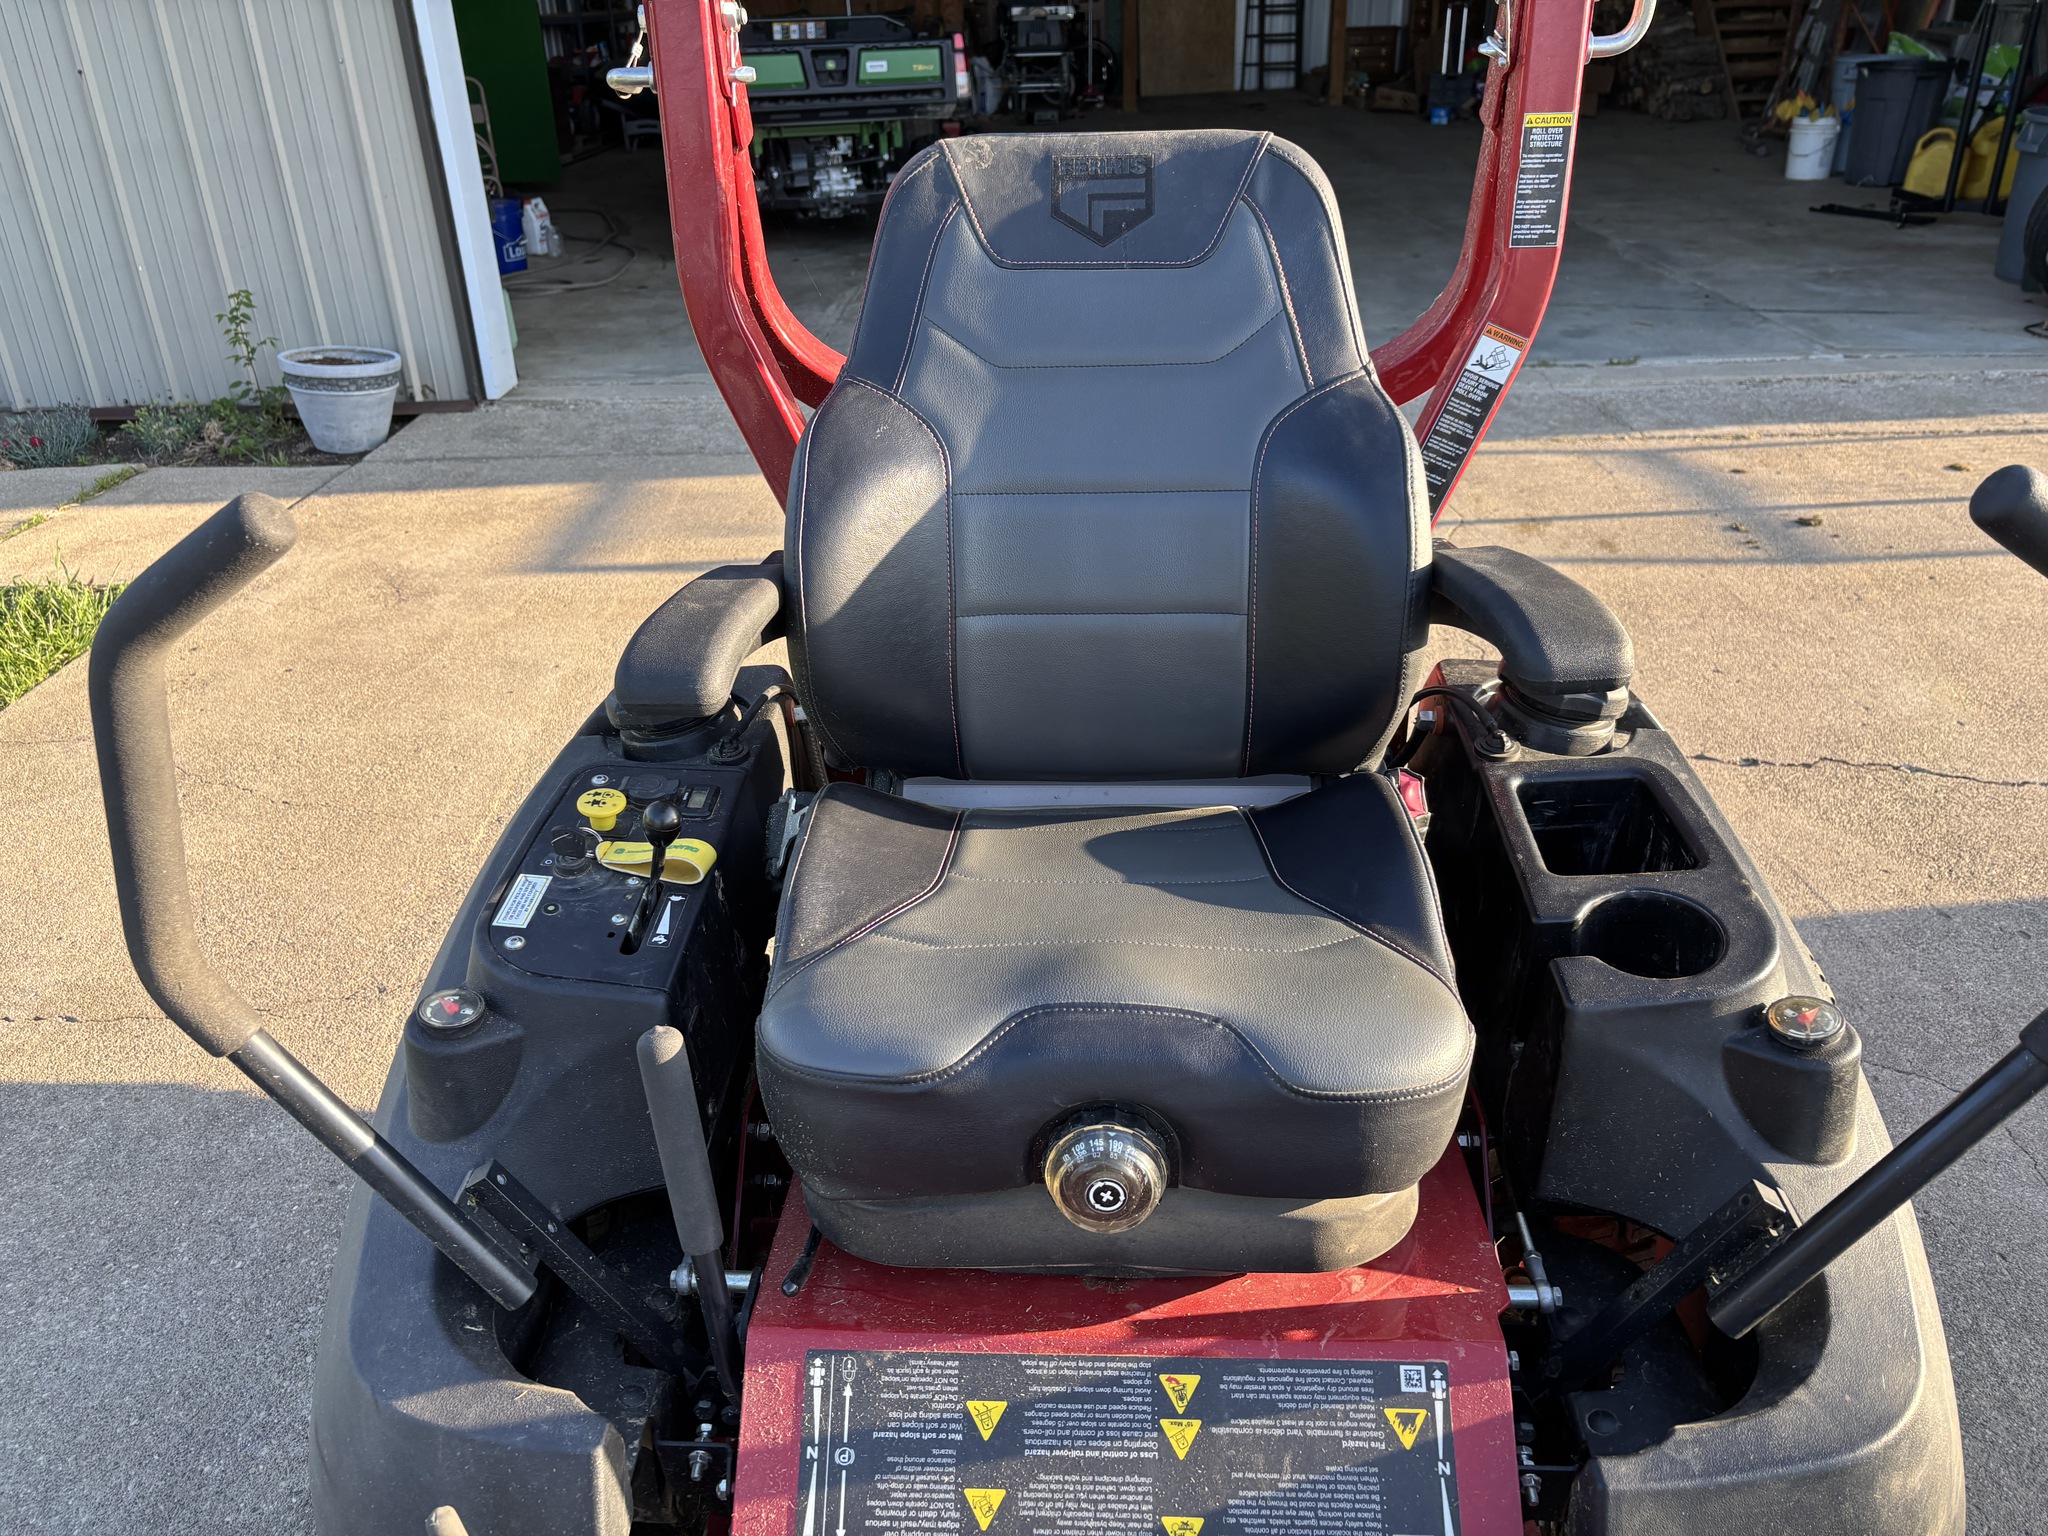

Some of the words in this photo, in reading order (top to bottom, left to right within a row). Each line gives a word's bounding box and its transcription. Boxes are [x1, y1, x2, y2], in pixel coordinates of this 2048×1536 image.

[1534, 116, 1571, 124] CAUTION
[1060, 156, 1147, 175] FERRIS
[1493, 329, 1524, 348] WARNING
[1461, 376, 1478, 387] INJURY
[1478, 383, 1486, 391] OR
[1463, 371, 1478, 381] AVOID
[1479, 377, 1500, 390] SERIOUS
[1457, 382, 1474, 392] DEATH
[1474, 389, 1489, 398] FROM
[1089, 1139, 1104, 1147] 145
[902, 1420, 923, 1428] slopes
[900, 1431, 920, 1439] slope
[1089, 1440, 1111, 1448] slopes
[1124, 1440, 1158, 1449] Operating
[1342, 1441, 1368, 1449] hazard
[806, 1446, 818, 1459] N
[1438, 1461, 1450, 1475] N
[1358, 1484, 1379, 1492] placing
[1260, 1490, 1284, 1498] stopped
[1345, 1520, 1363, 1528] safety
[1365, 1519, 1382, 1529] Keep
